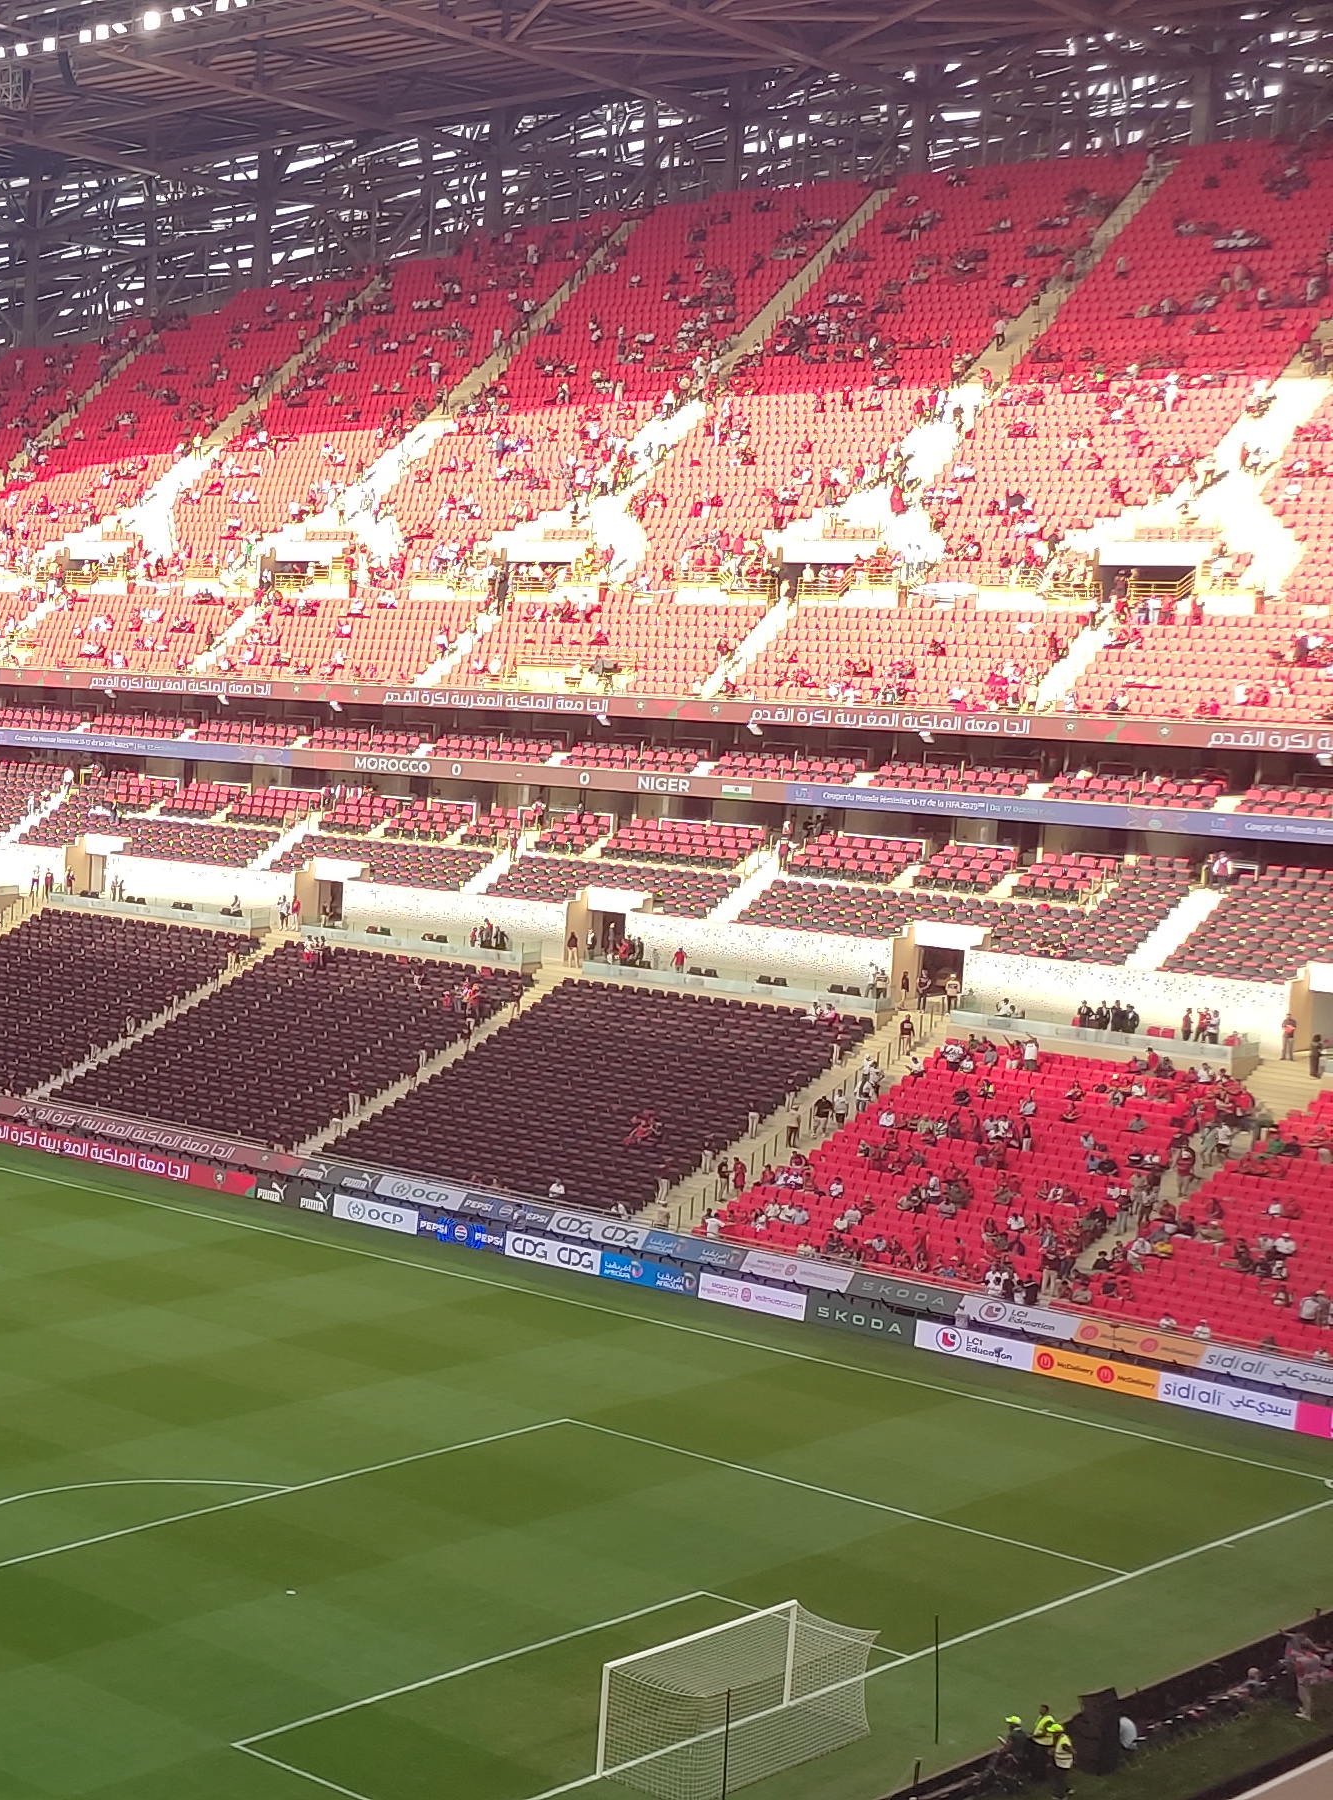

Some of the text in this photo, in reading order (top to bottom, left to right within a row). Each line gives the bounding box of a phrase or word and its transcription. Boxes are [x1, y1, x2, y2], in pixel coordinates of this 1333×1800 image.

[383, 691, 419, 704] القدم
[421, 692, 449, 706] لكرة
[749, 708, 793, 724] القدم
[797, 710, 831, 726] لكرة
[835, 710, 898, 728] المغربية
[902, 712, 961, 731] الملكية
[1208, 732, 1313, 751] لكرة القدم
[355, 756, 430, 774] MOROCCO
[451, 764, 461, 776] 0
[579, 772, 589, 784] 0
[637, 776, 690, 792] NIGER
[11, 1128, 38, 1147] لكرة
[91, 1144, 136, 1168] الملكية
[412, 1188, 449, 1202] OCP
[368, 1208, 403, 1224] OCP
[464, 1200, 549, 1224] PEPSI EPSI
[420, 1221, 504, 1246] PEPSI PEPSI
[556, 1217, 591, 1235] CDG
[602, 1226, 639, 1245] CDG
[512, 1238, 593, 1270] CDG CDG
[862, 1281, 946, 1306] SKODA
[817, 1306, 903, 1335] SKODA
[1011, 1309, 1028, 1318] LCI
[1008, 1316, 1055, 1331] Education
[967, 1336, 983, 1346] LCI
[1163, 1382, 1195, 1401] sidi
[1229, 1396, 1255, 1410] علي
